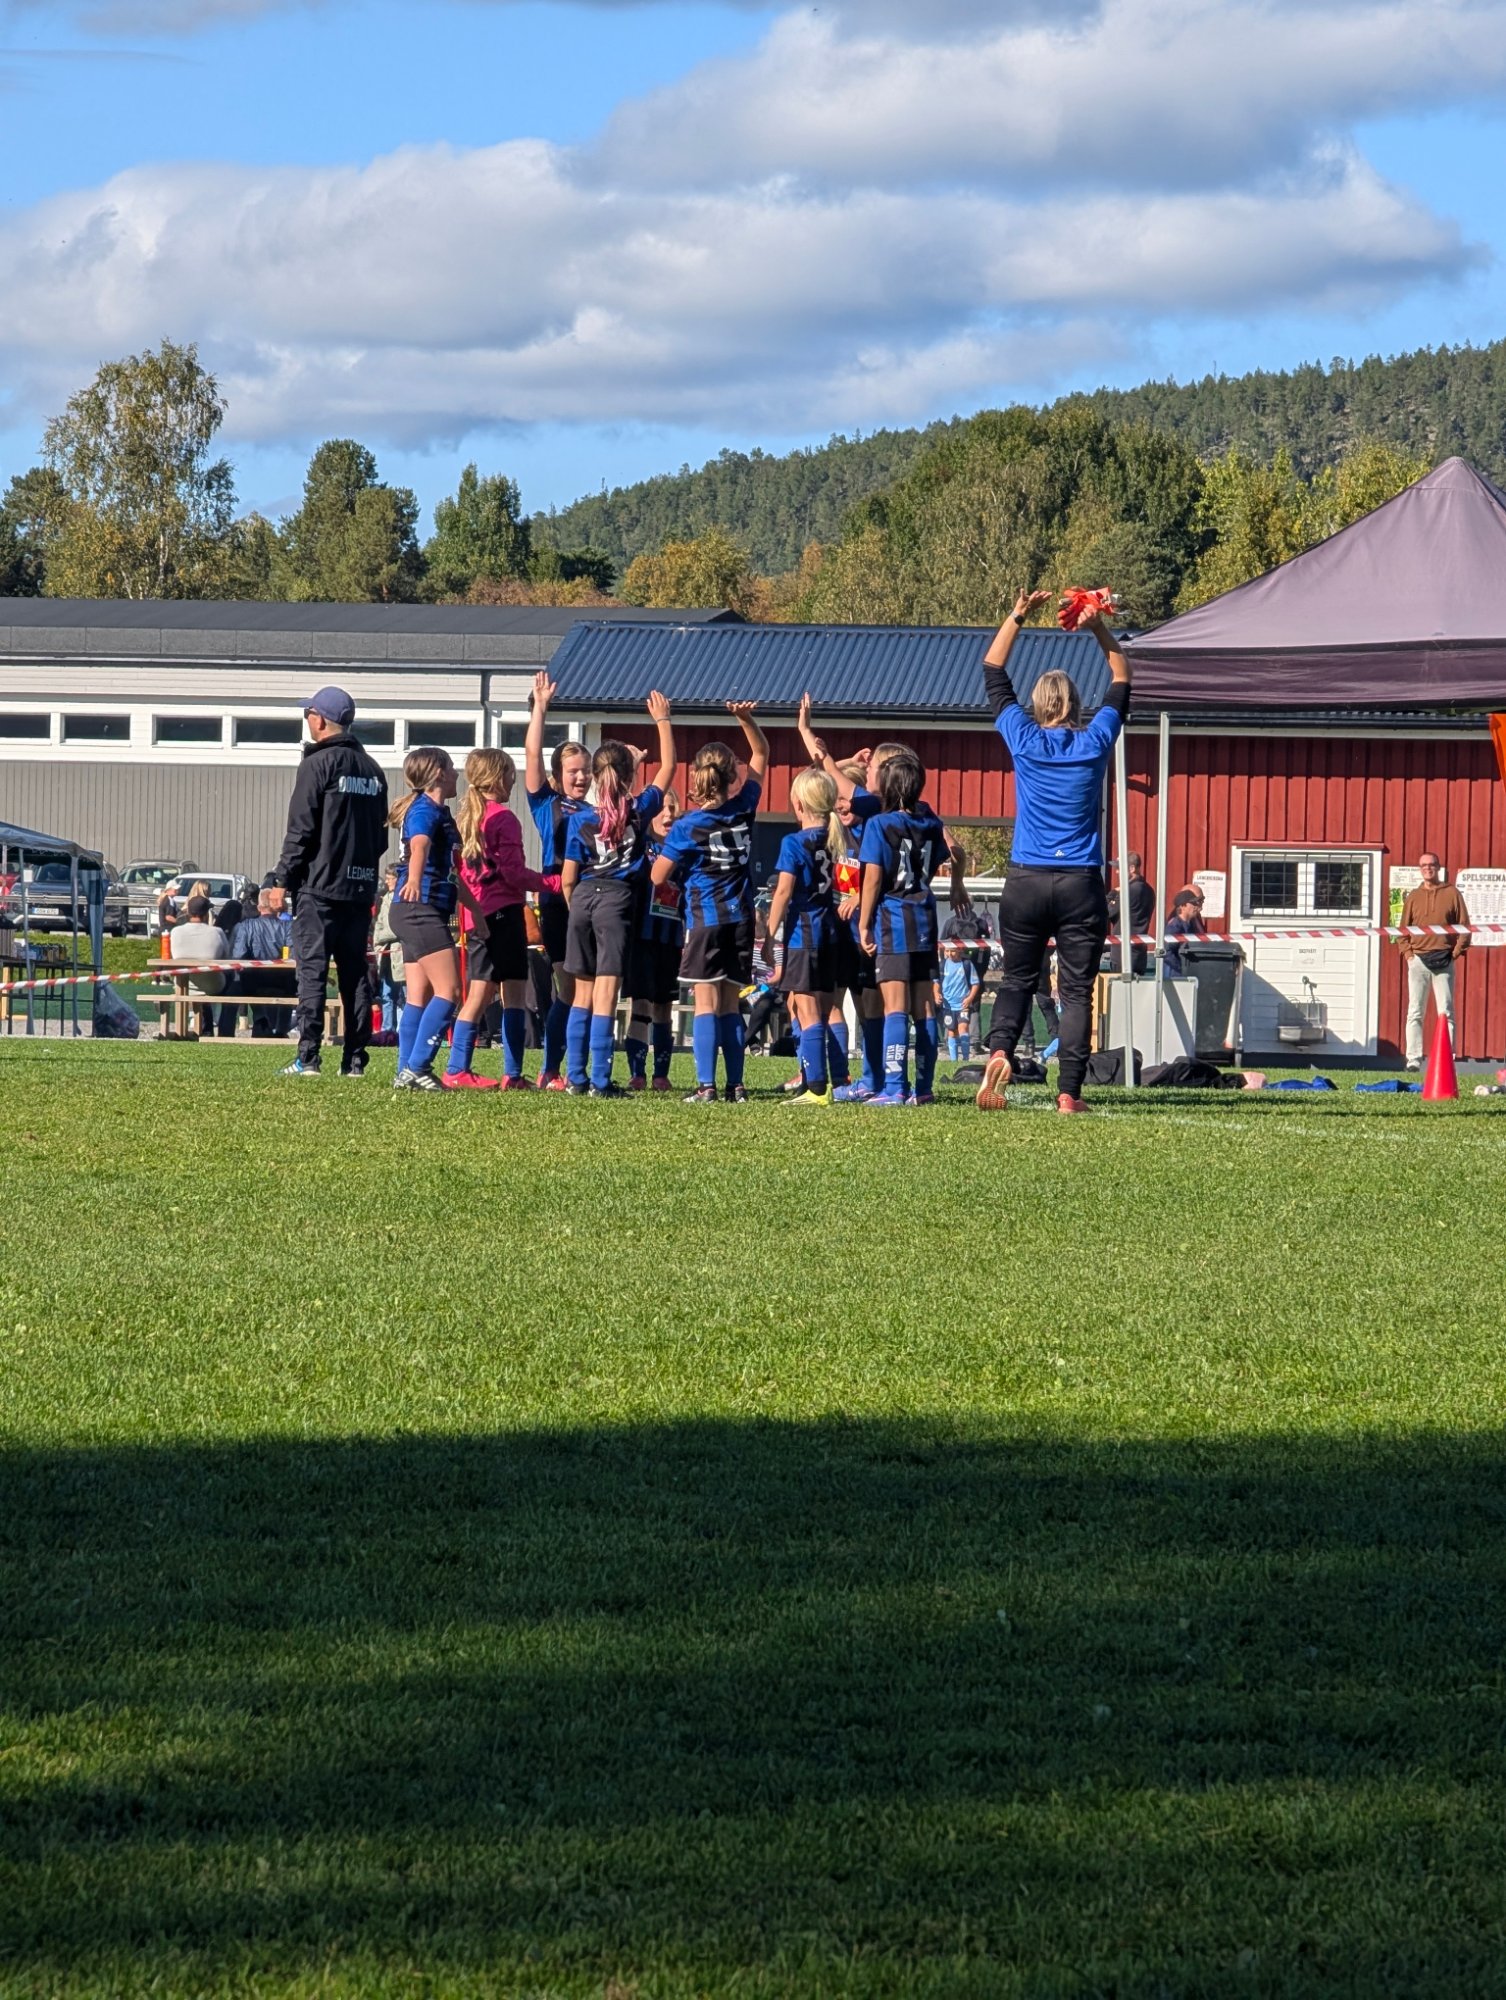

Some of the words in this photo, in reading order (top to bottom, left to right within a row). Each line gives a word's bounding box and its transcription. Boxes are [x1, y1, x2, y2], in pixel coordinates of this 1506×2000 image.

[709, 822, 751, 870] 45
[897, 838, 932, 889] 11
[347, 866, 375, 881] LEDARE
[815, 850, 831, 894] 3
[1462, 873, 1506, 882] SPELSCHEMA
